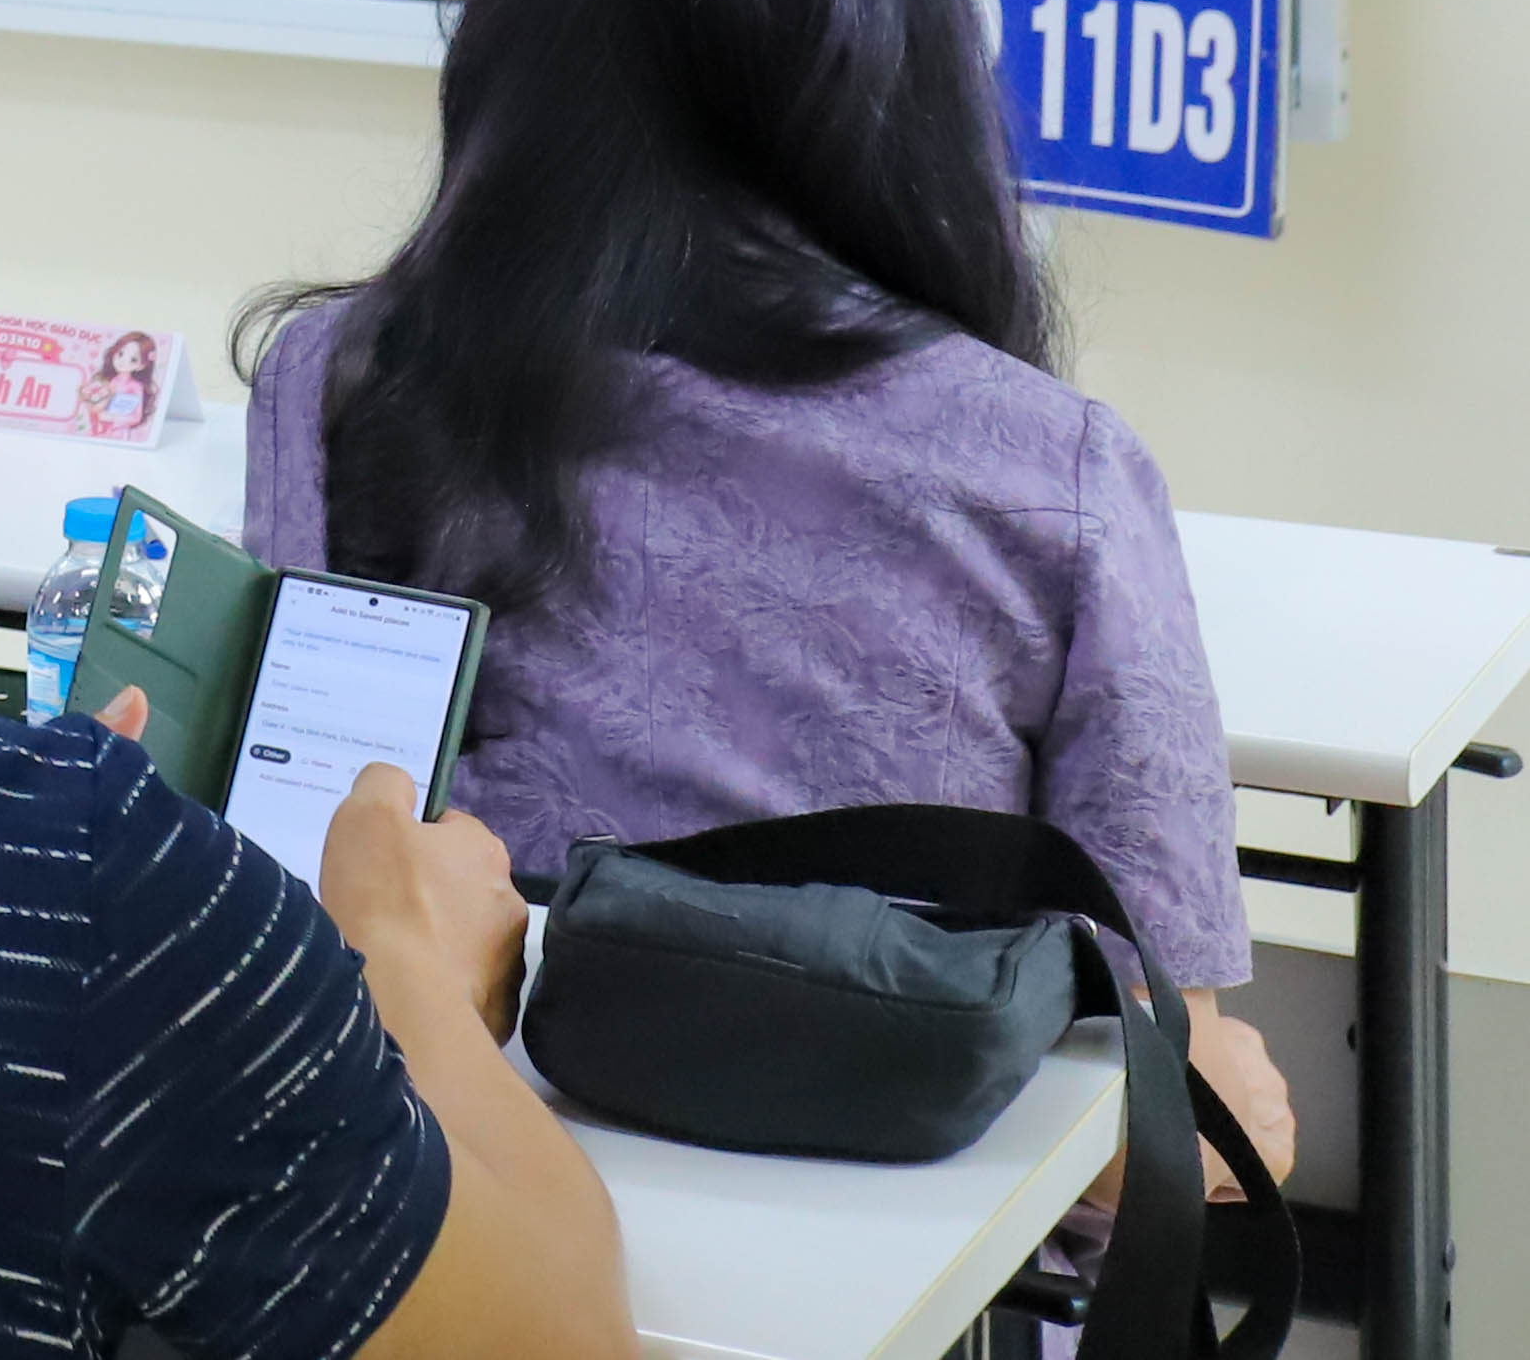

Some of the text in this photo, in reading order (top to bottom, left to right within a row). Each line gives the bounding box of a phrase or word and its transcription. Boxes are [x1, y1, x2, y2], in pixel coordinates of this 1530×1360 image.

[25, 319, 47, 332] HỌC
[50, 321, 76, 338] GIÁO
[78, 328, 103, 344] DỤC
[16, 375, 52, 409] An
